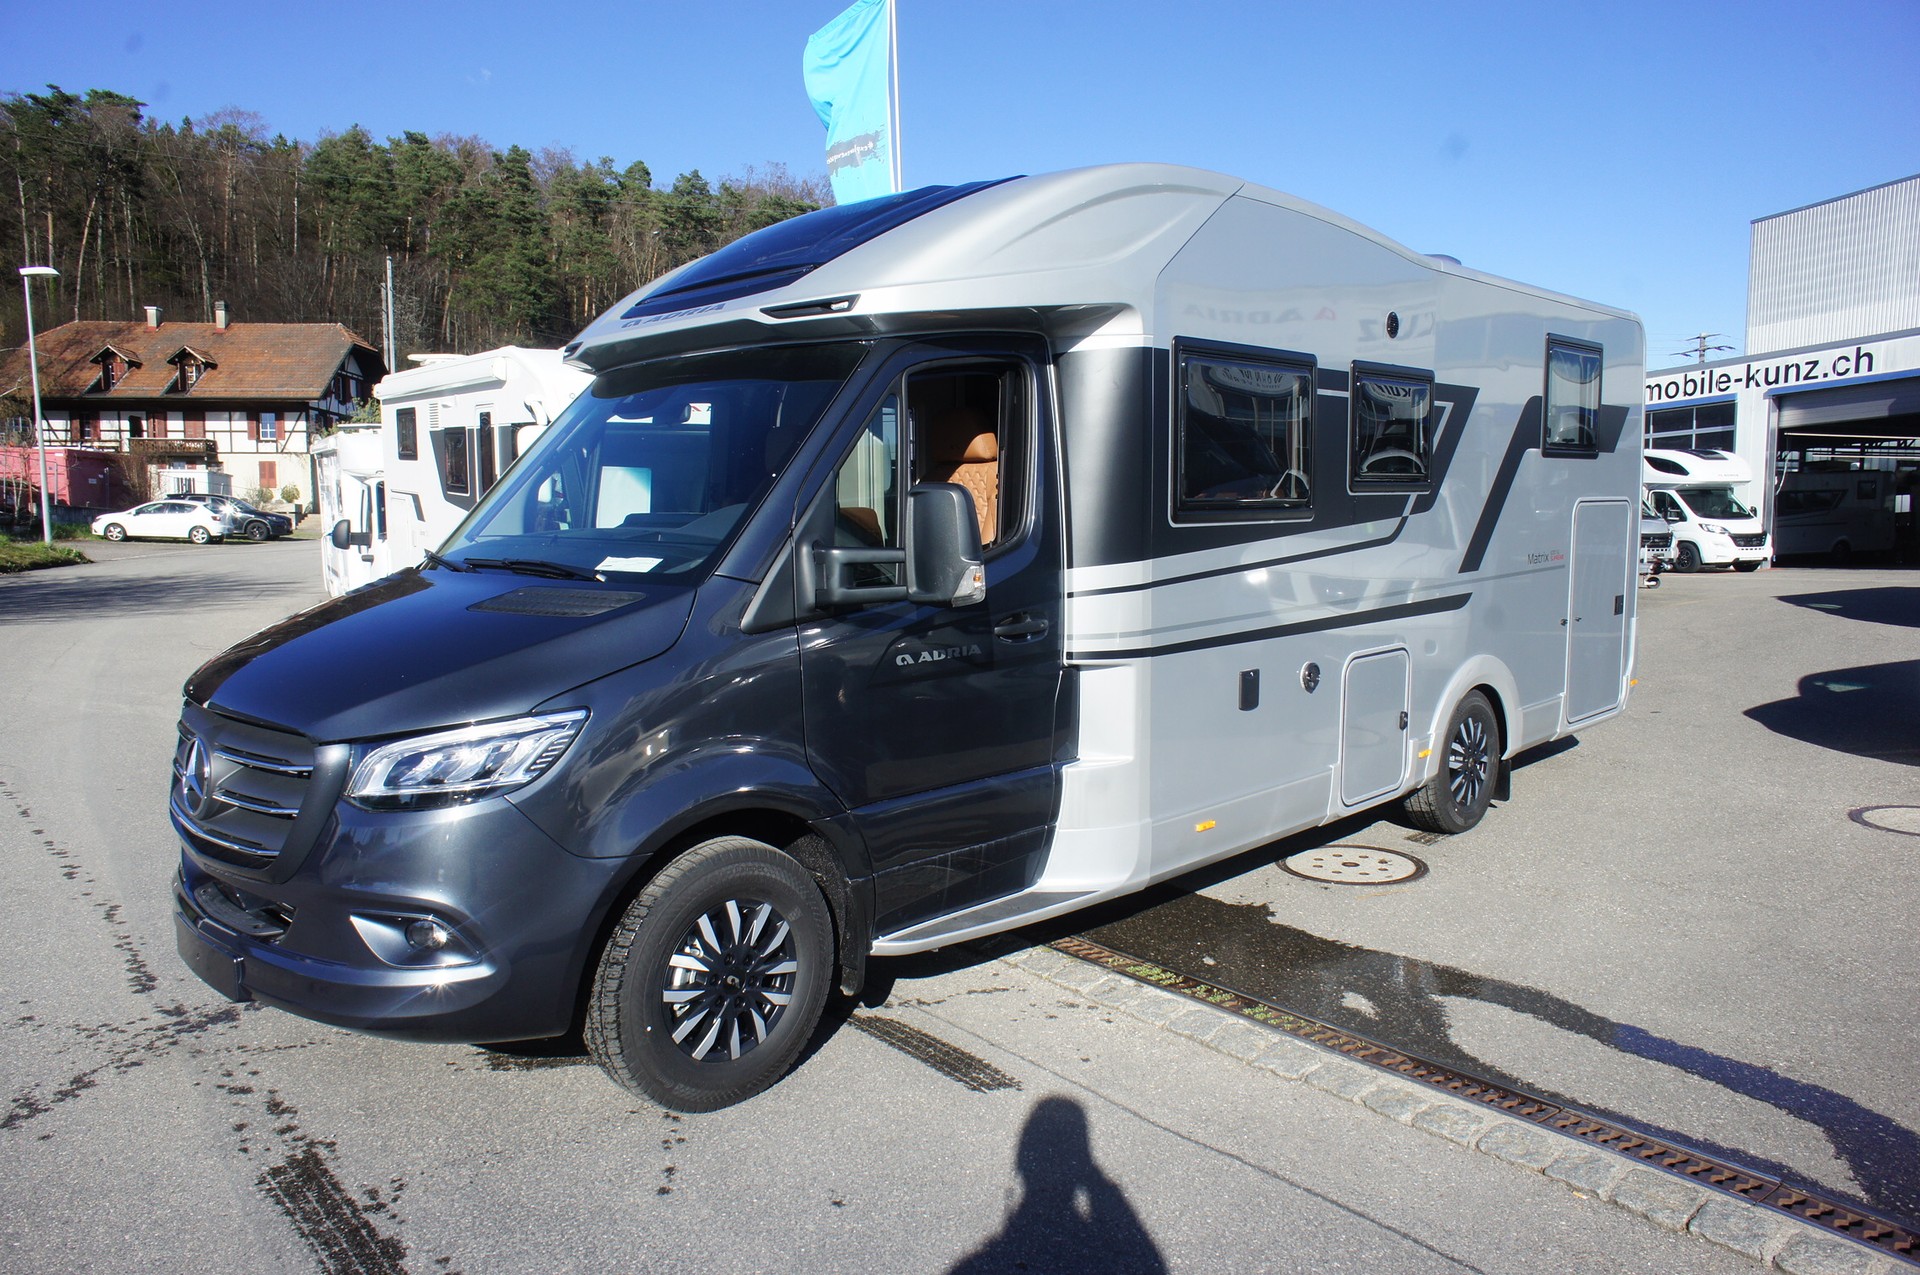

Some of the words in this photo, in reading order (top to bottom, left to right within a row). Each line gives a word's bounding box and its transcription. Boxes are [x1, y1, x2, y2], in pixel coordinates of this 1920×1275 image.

[643, 303, 727, 325] ADRIA
[1527, 552, 1550, 565] Matrix
[918, 644, 982, 663] ADRIA
